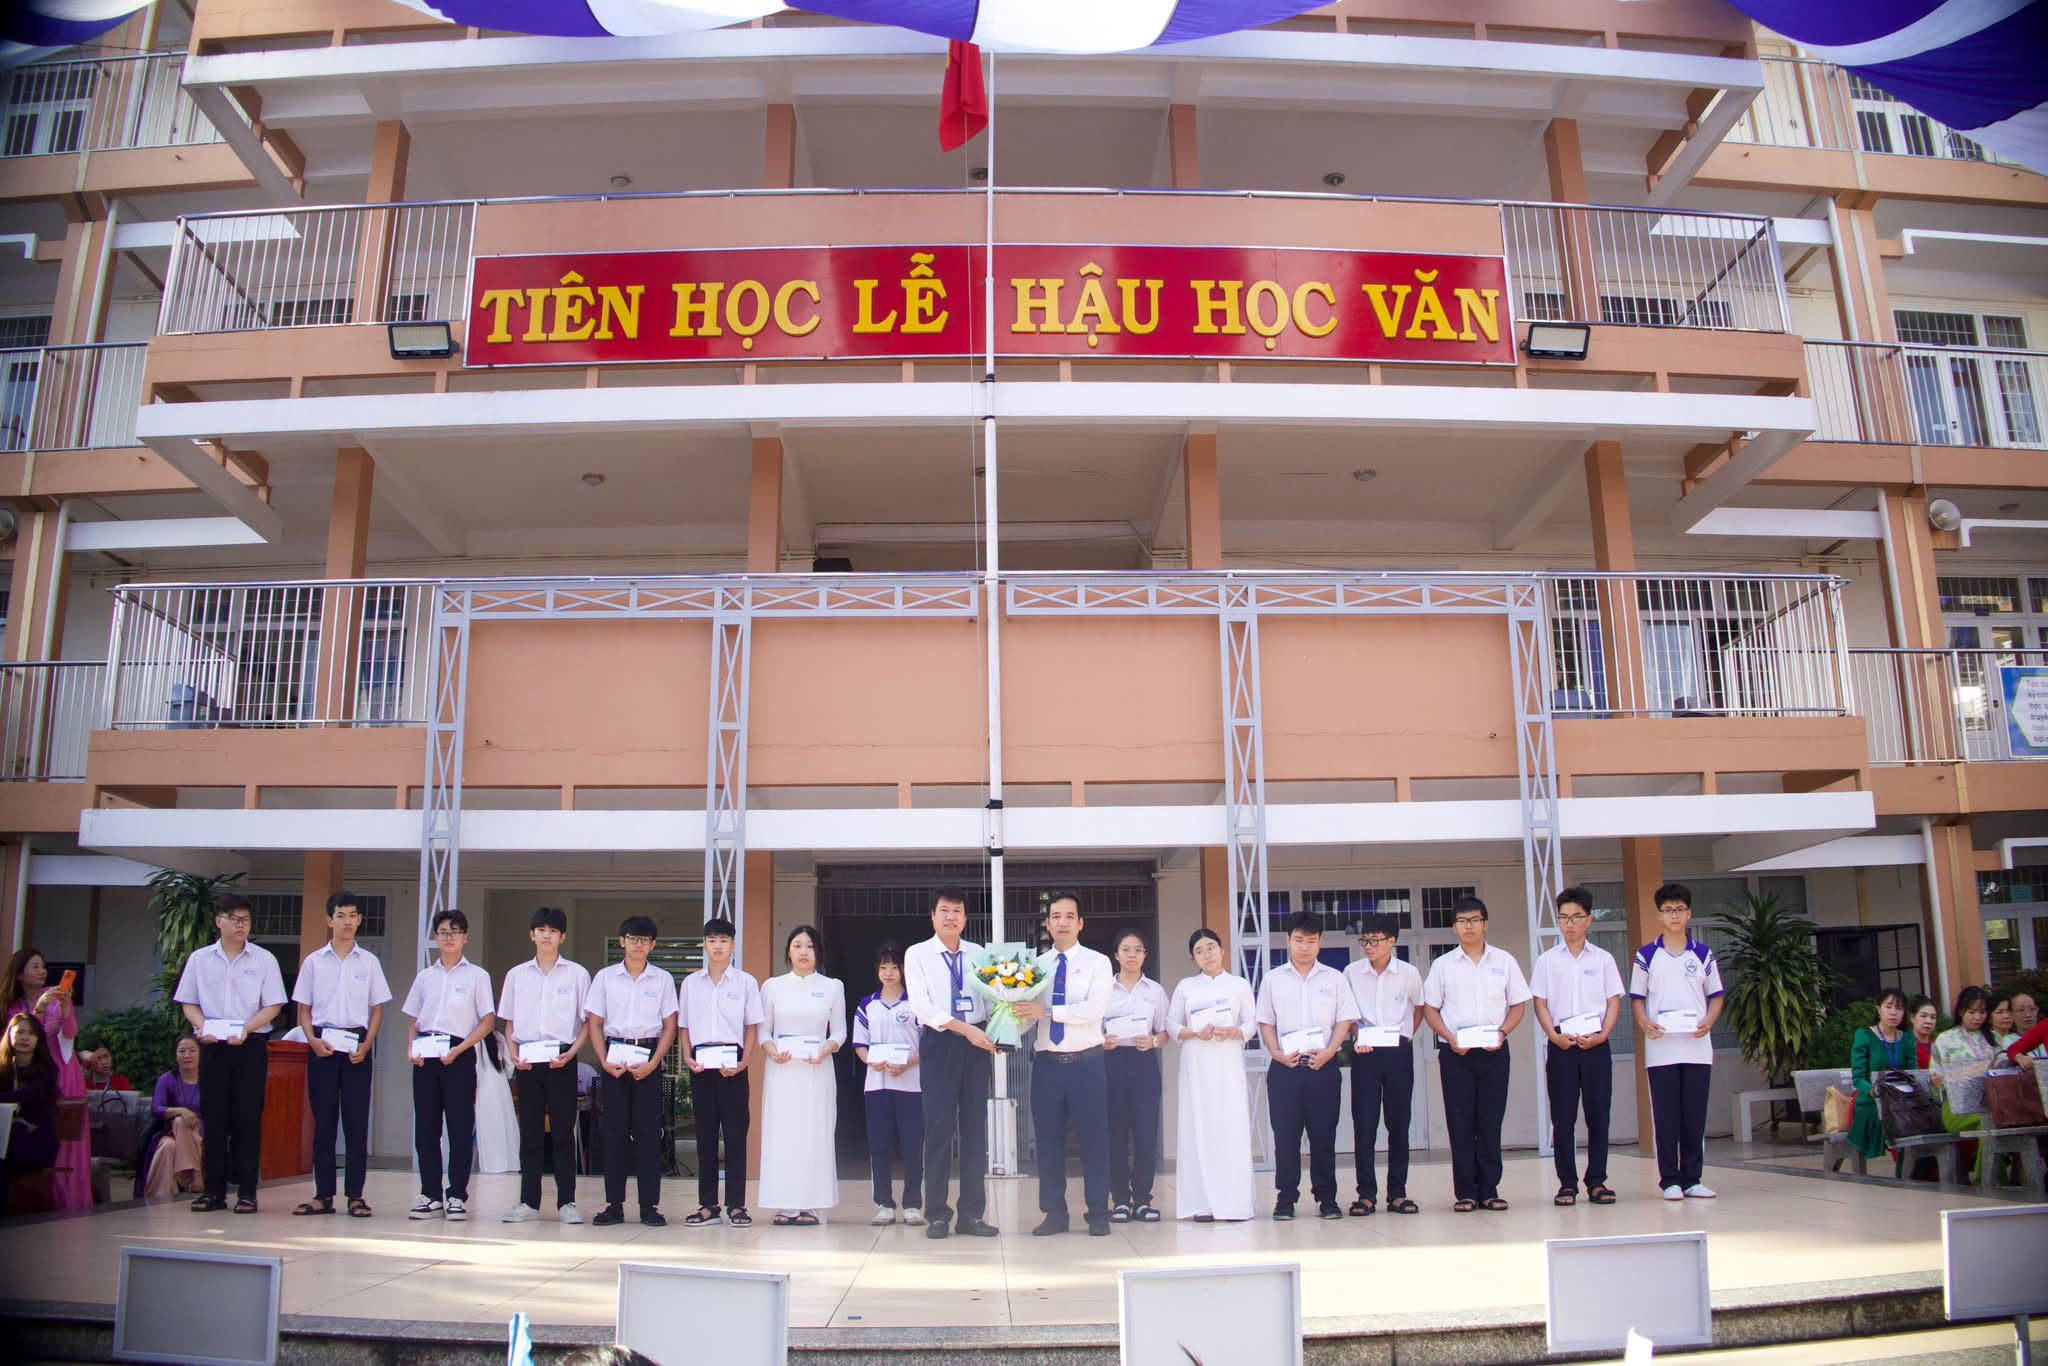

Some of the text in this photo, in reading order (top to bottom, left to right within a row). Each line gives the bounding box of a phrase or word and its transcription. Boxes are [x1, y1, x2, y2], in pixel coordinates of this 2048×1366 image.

[480, 252, 1501, 351] TIÊN HỌC LỄ HẬU HỌC VĂN
